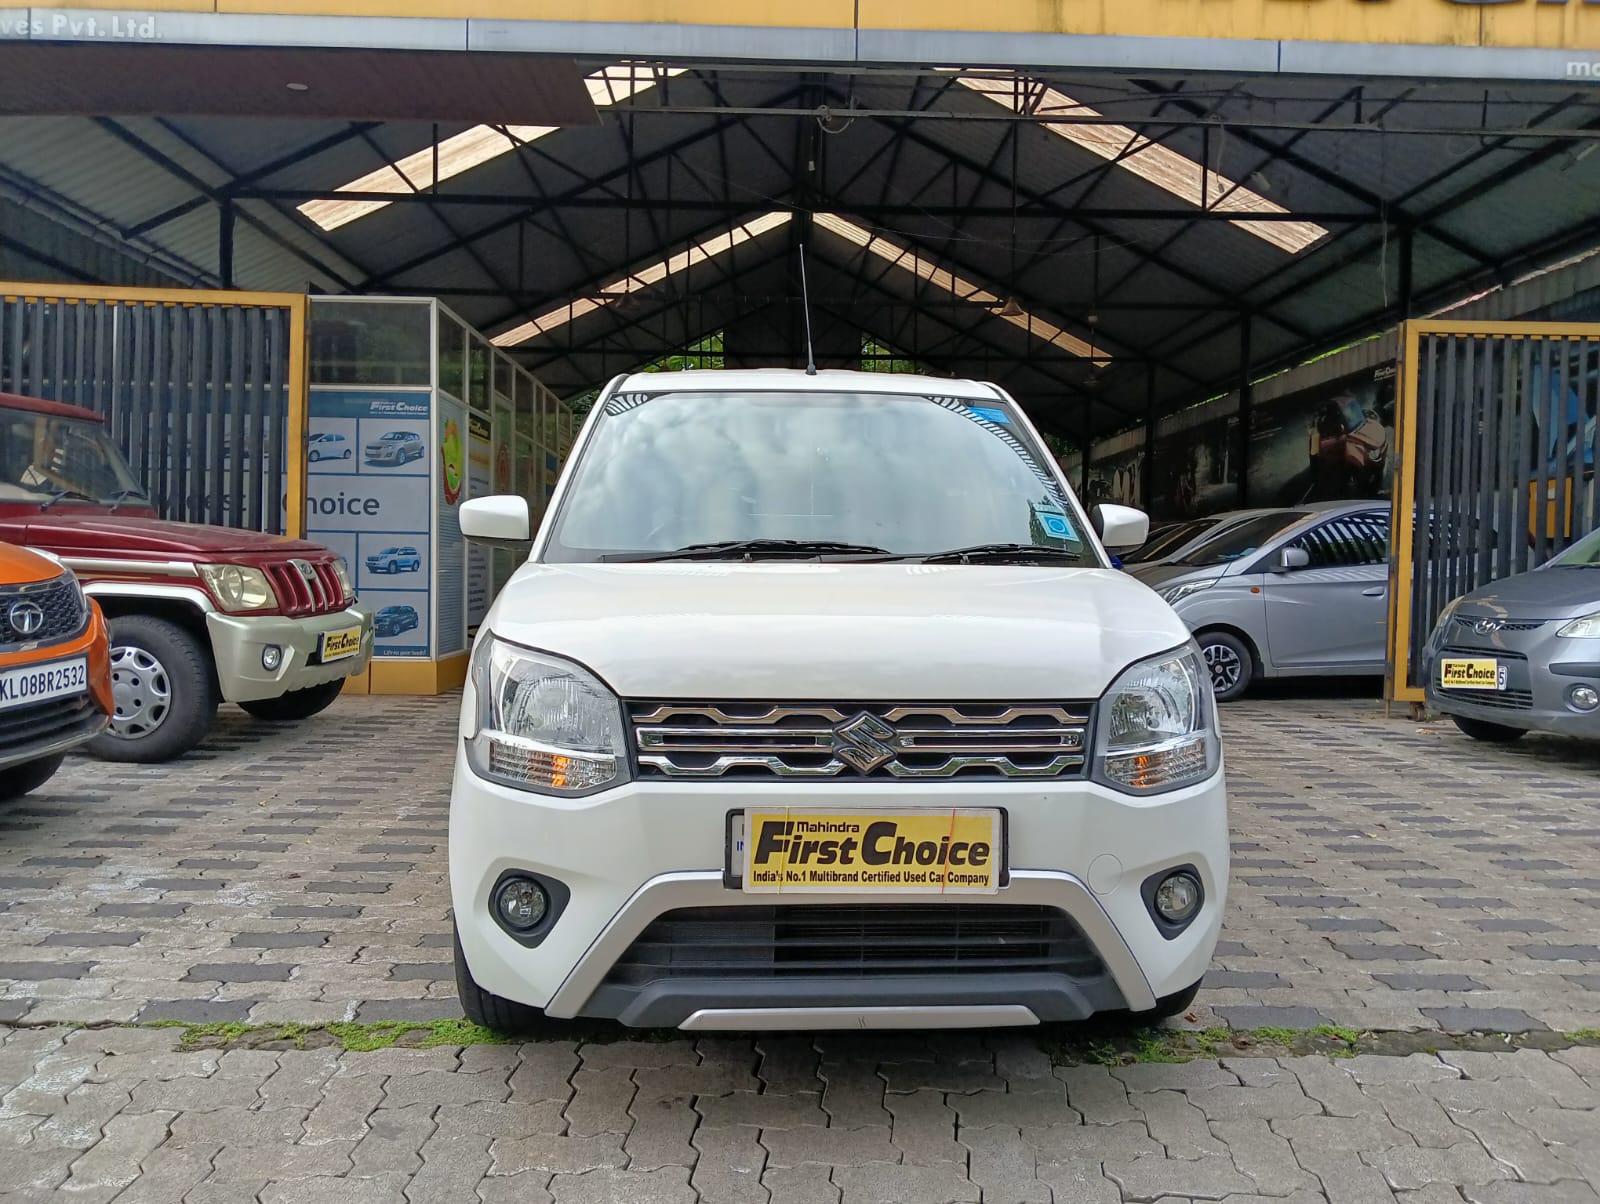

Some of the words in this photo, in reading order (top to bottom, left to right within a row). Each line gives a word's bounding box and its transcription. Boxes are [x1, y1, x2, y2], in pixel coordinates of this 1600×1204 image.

[53, 14, 105, 37] Pvt.
[112, 16, 162, 38] Ltd.
[1444, 663, 1466, 678] First
[1466, 663, 1495, 679] Choice
[0, 664, 85, 701] KL08BR2532
[797, 821, 860, 832] Mahindra
[754, 821, 858, 865] First
[861, 821, 990, 866] Choice
[753, 870, 783, 882] India's
[786, 870, 806, 882] No.1
[809, 870, 858, 882] Multibrand
[861, 871, 901, 882] Certified
[903, 871, 926, 883] Used
[929, 871, 945, 883] Car
[947, 872, 990, 885] Company
